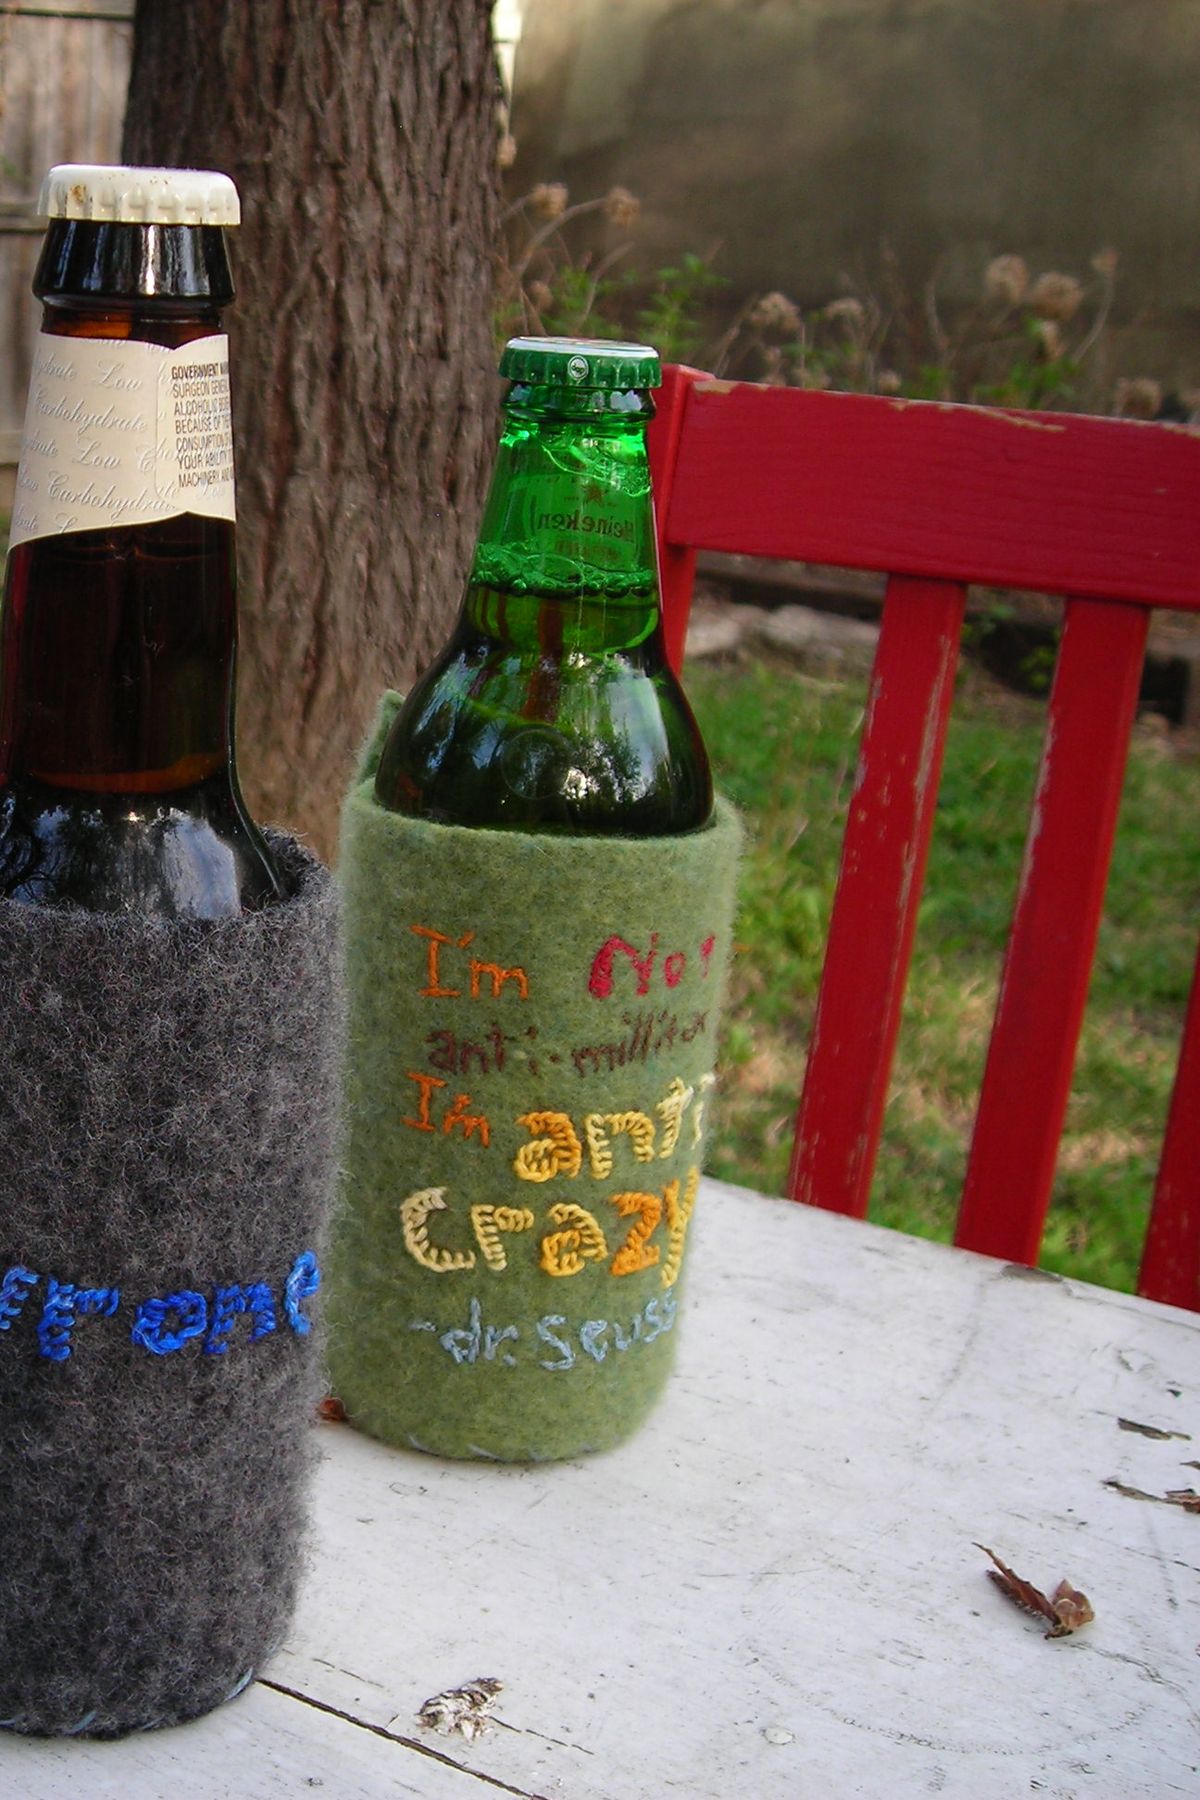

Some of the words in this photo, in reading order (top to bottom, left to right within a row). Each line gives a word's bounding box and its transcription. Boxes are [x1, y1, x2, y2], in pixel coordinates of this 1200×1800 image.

[173, 381, 210, 398] SURGEON
[176, 416, 212, 434] BECAUSE
[178, 453, 203, 470] YOUR
[410, 923, 529, 999] I'm
